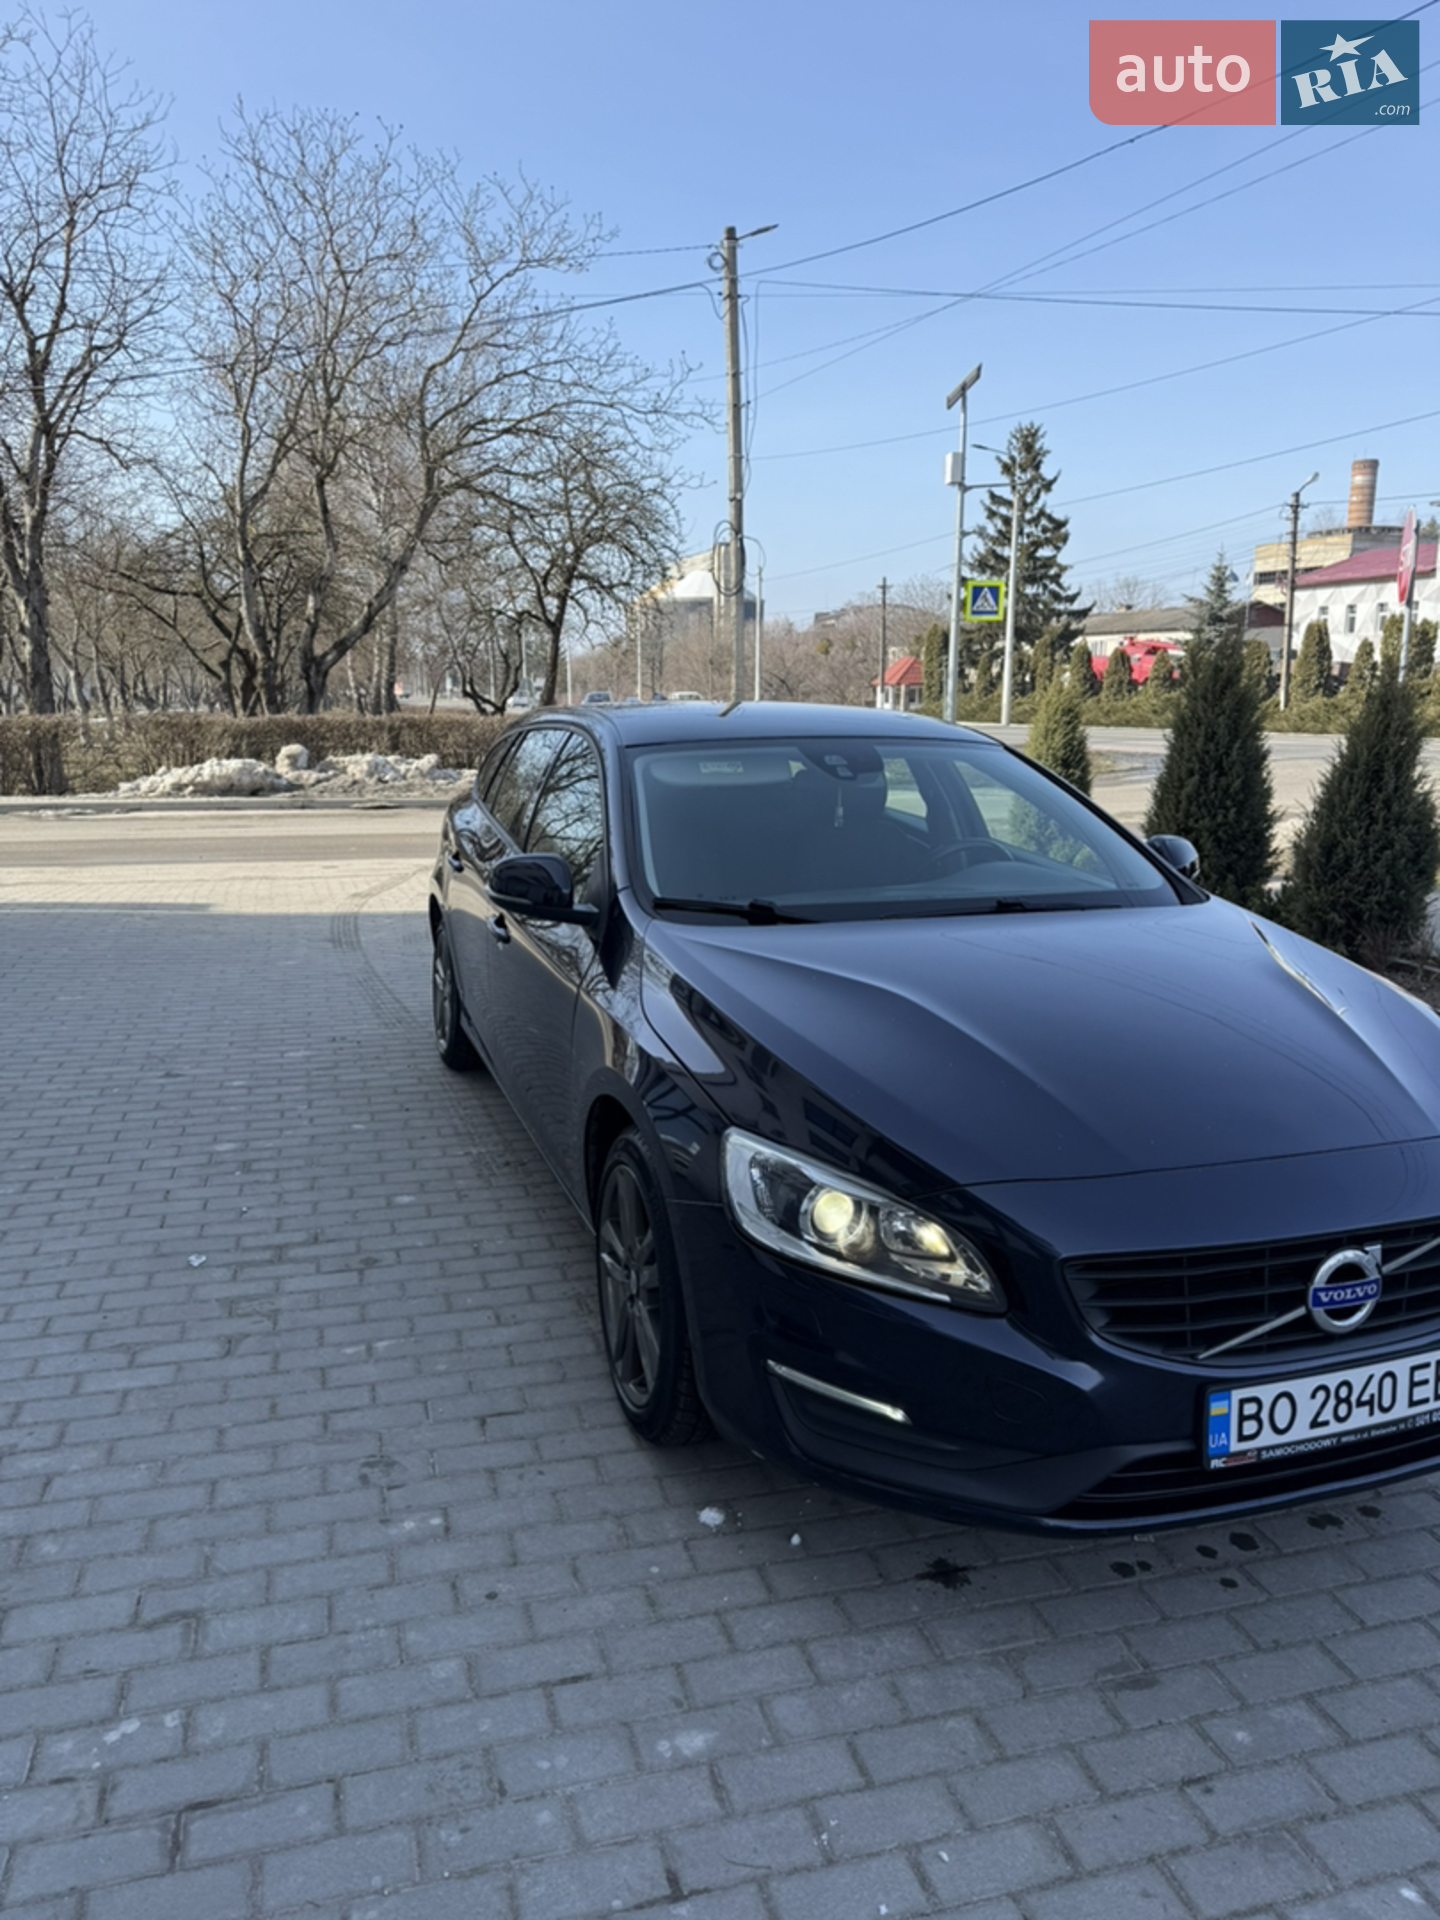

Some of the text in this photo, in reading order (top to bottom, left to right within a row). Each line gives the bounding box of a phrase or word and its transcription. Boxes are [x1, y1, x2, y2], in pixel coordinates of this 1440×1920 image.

[1316, 1282, 1378, 1303] VOLVO
[1236, 1391, 1298, 1444] BO
[1309, 1370, 1398, 1430] 2840
[1208, 1431, 1228, 1449] UA
